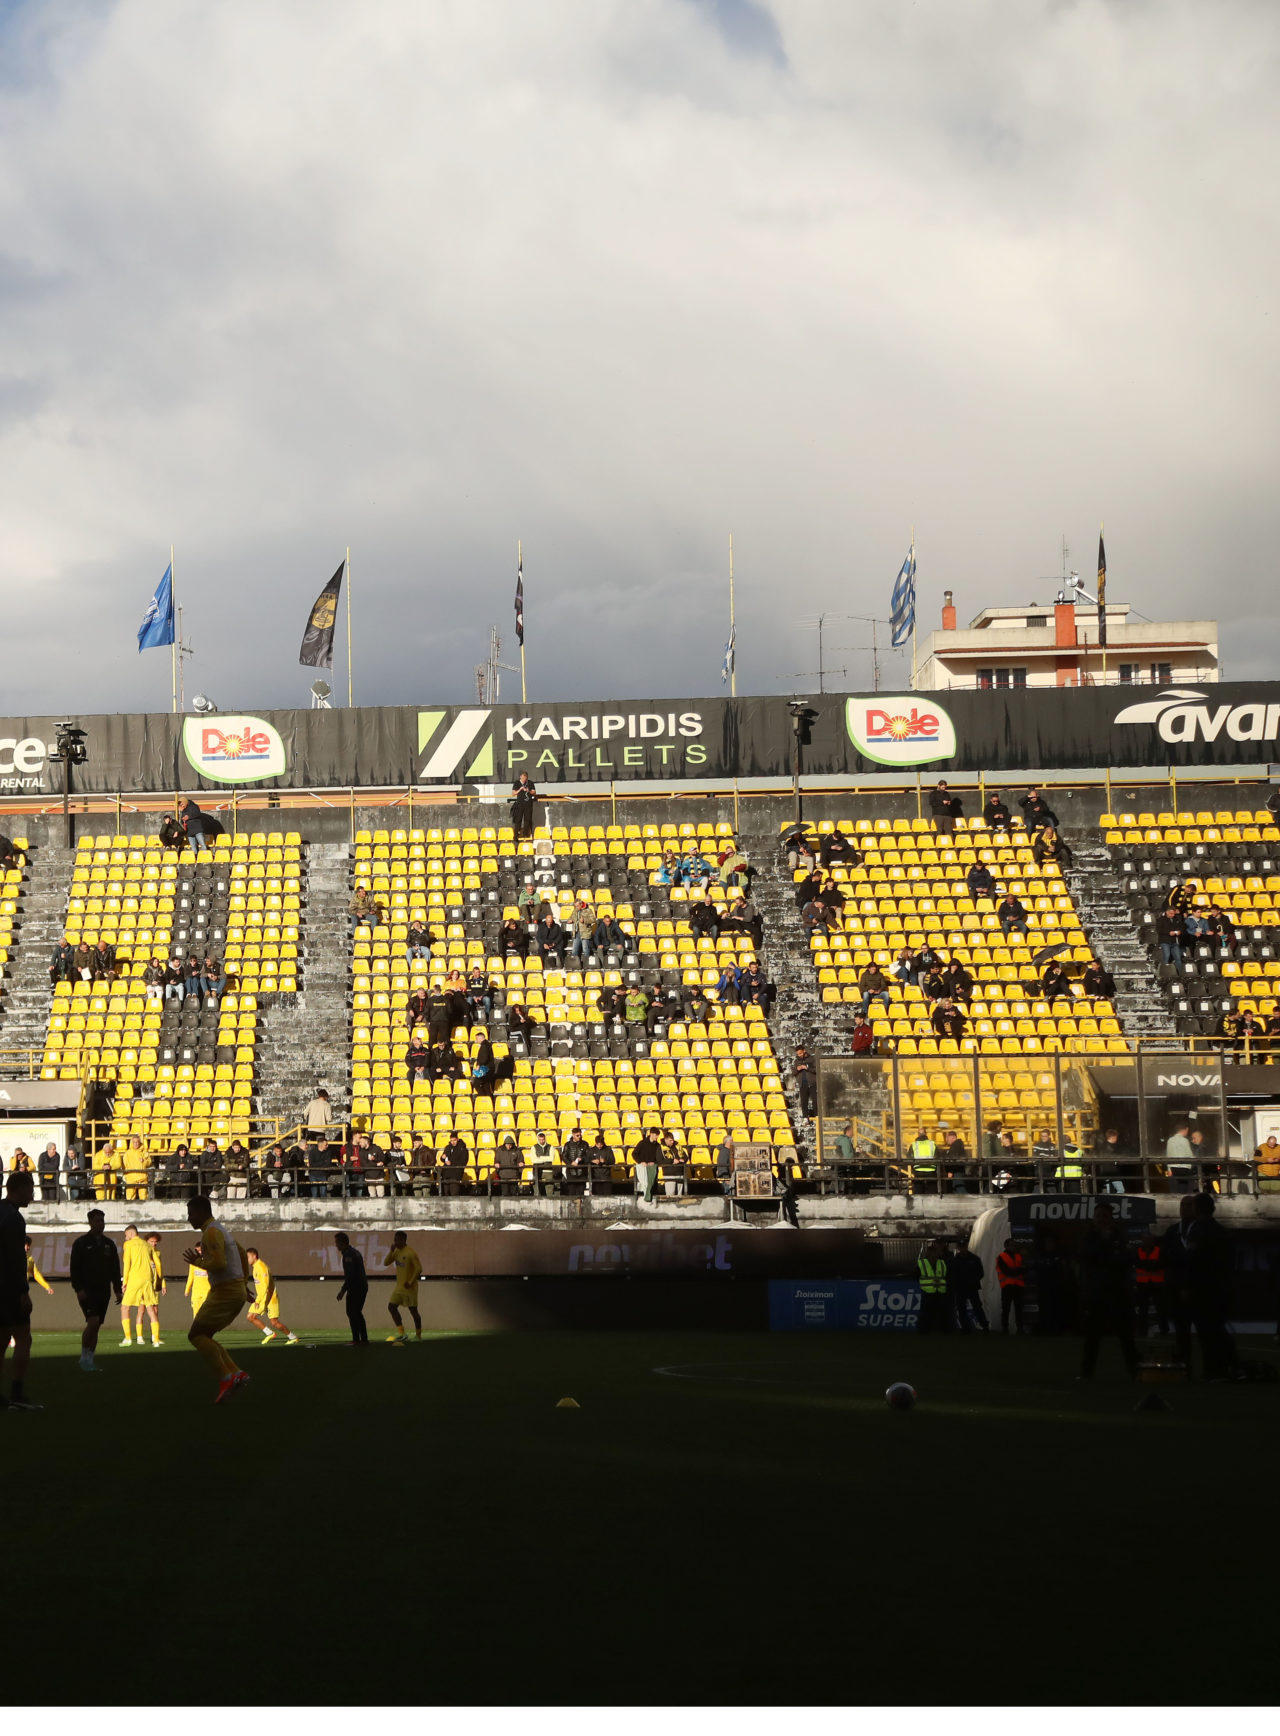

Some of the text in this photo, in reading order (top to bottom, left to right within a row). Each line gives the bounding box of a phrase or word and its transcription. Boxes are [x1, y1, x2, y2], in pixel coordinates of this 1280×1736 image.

[505, 712, 704, 742] KARIPIDIS
[866, 708, 939, 740] Dole
[202, 727, 271, 758] Dole
[507, 744, 708, 769] PALLETS
[1, 777, 46, 789] RENTAL
[794, 1289, 834, 1298] Stoiximan
[857, 1314, 918, 1327] SUPER
